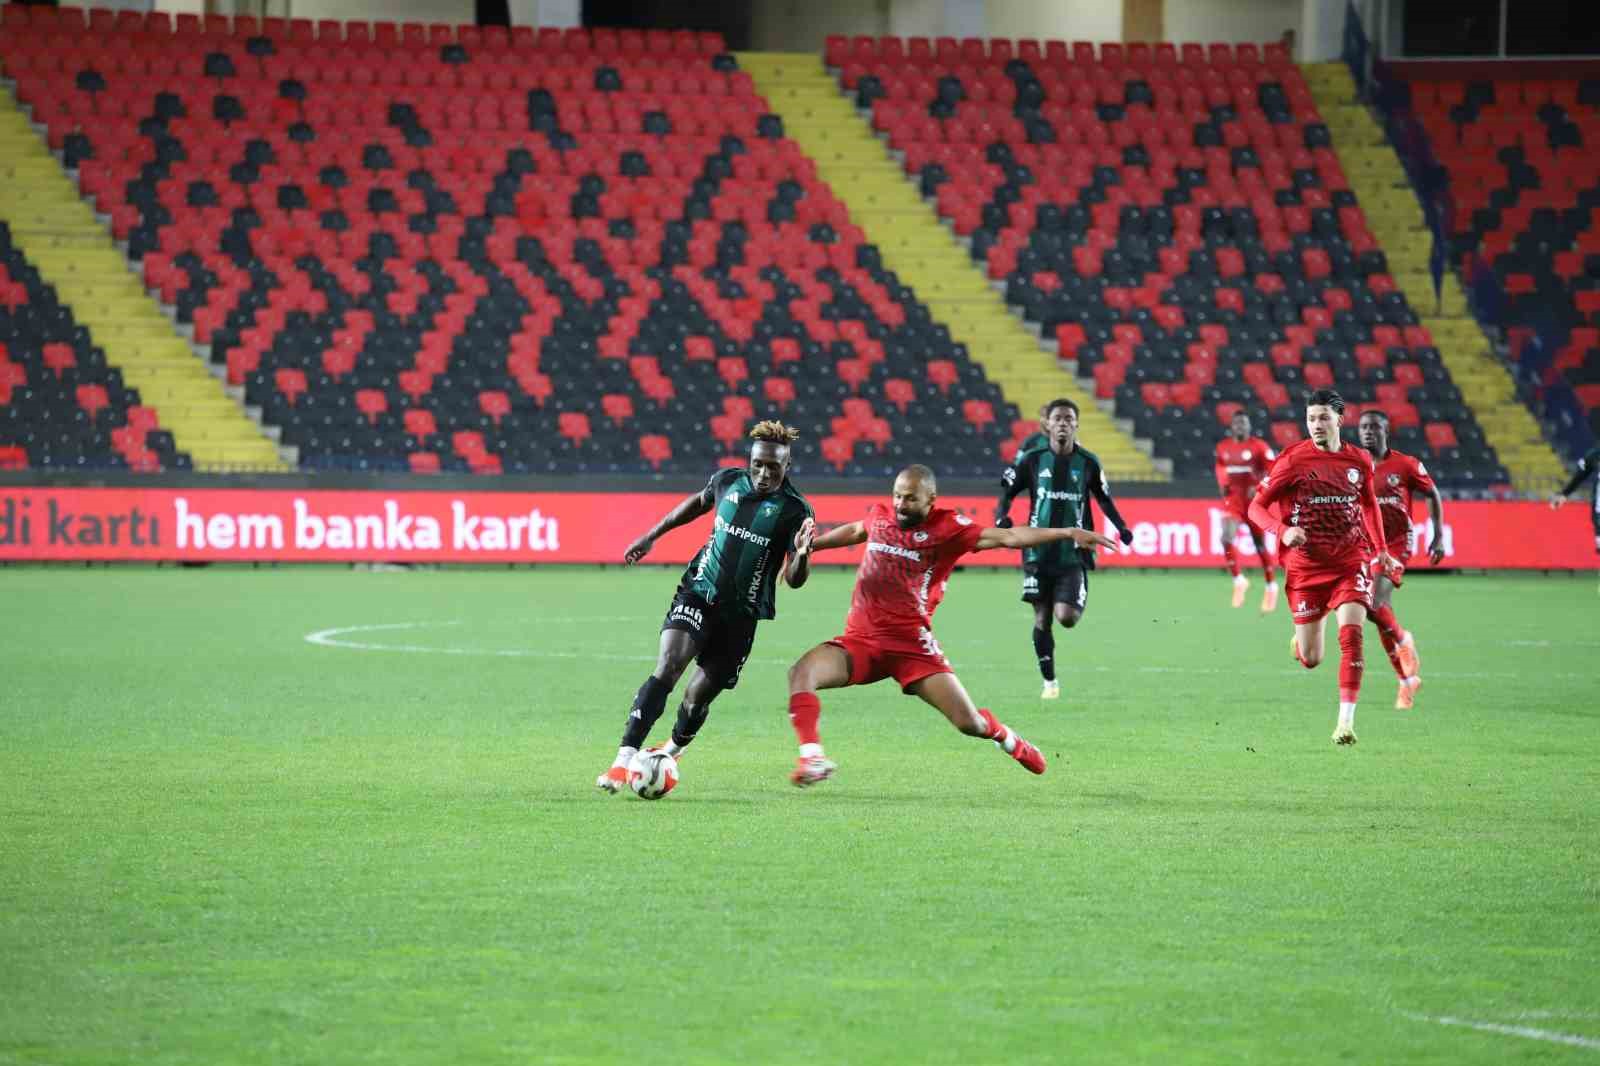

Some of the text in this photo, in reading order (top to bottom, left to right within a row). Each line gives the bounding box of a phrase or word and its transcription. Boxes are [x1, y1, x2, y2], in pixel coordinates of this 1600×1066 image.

[47, 496, 160, 546] kartı
[174, 497, 284, 549] hem
[294, 497, 442, 550] banka
[452, 500, 559, 551] kartı
